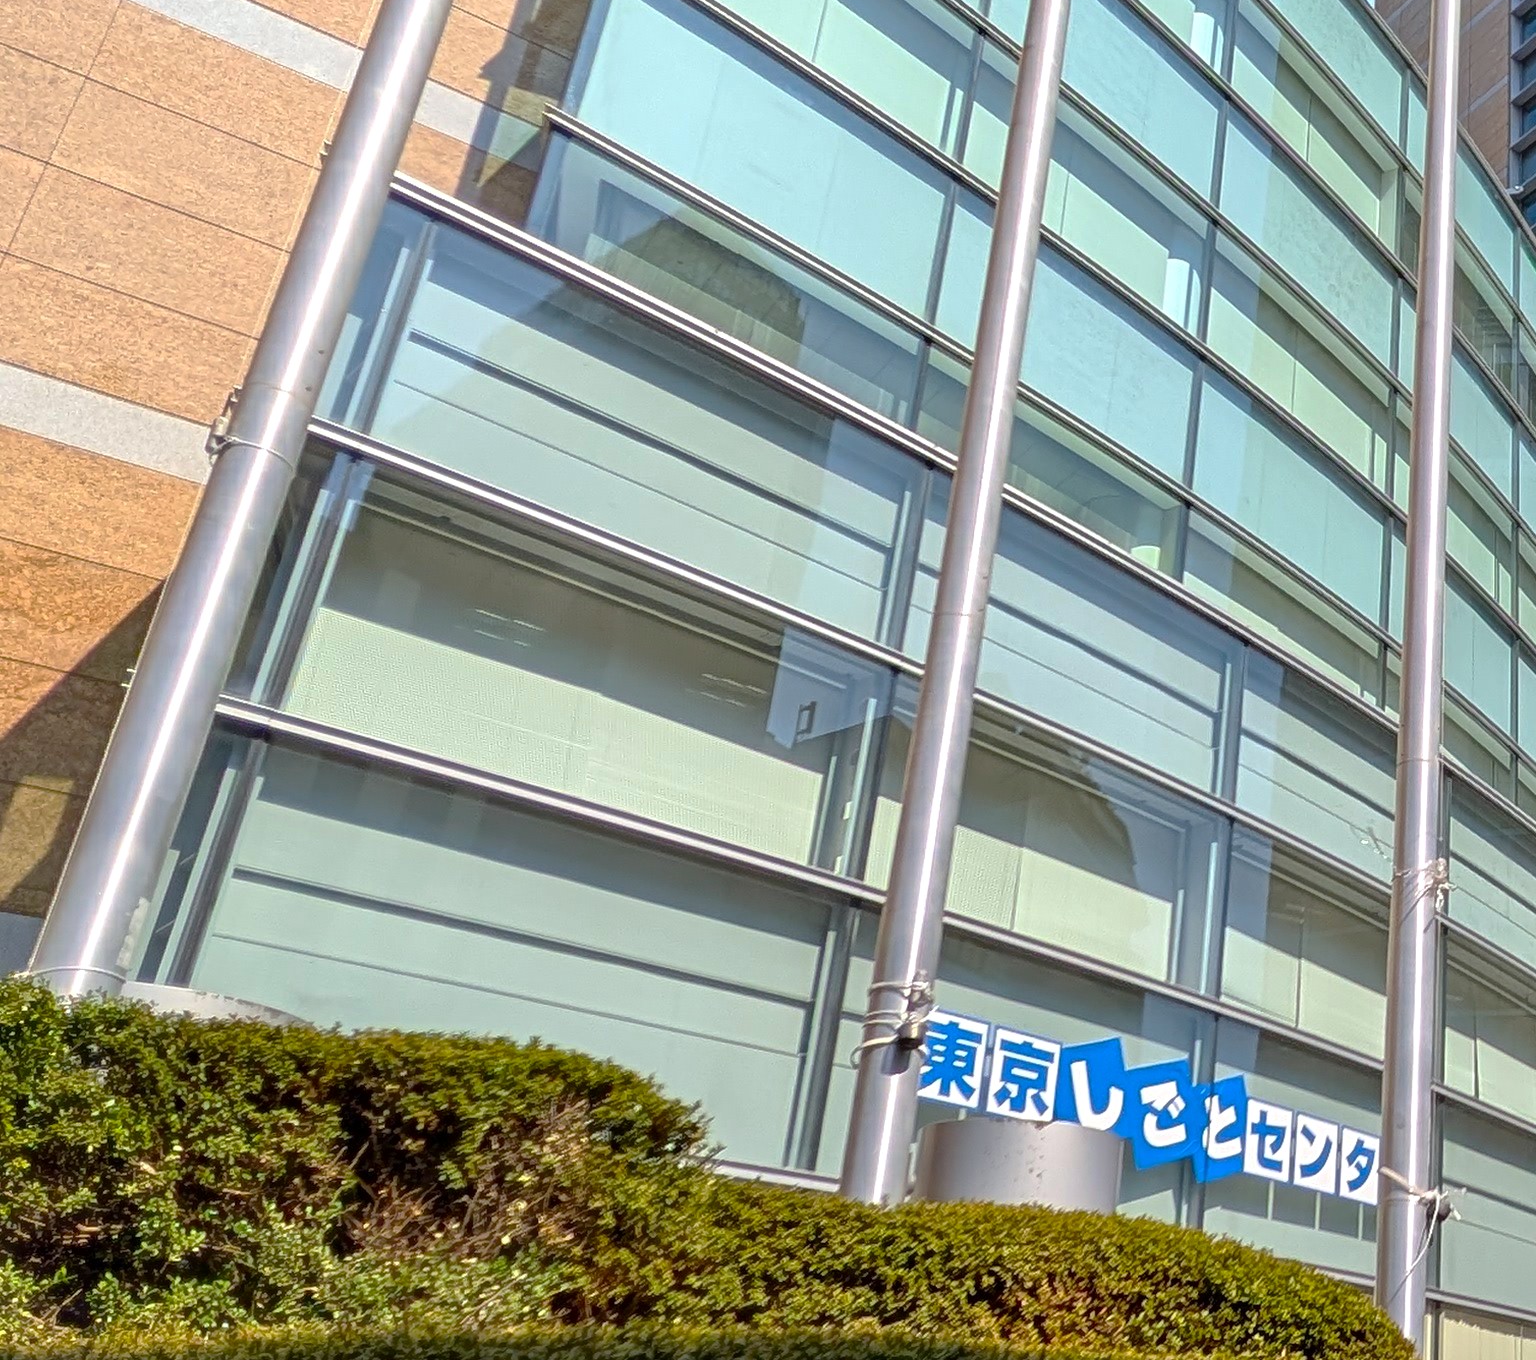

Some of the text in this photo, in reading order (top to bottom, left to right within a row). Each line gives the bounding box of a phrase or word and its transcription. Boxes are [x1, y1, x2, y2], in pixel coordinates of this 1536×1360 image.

[918, 1020, 1378, 1193] 東京しごとセンタ
